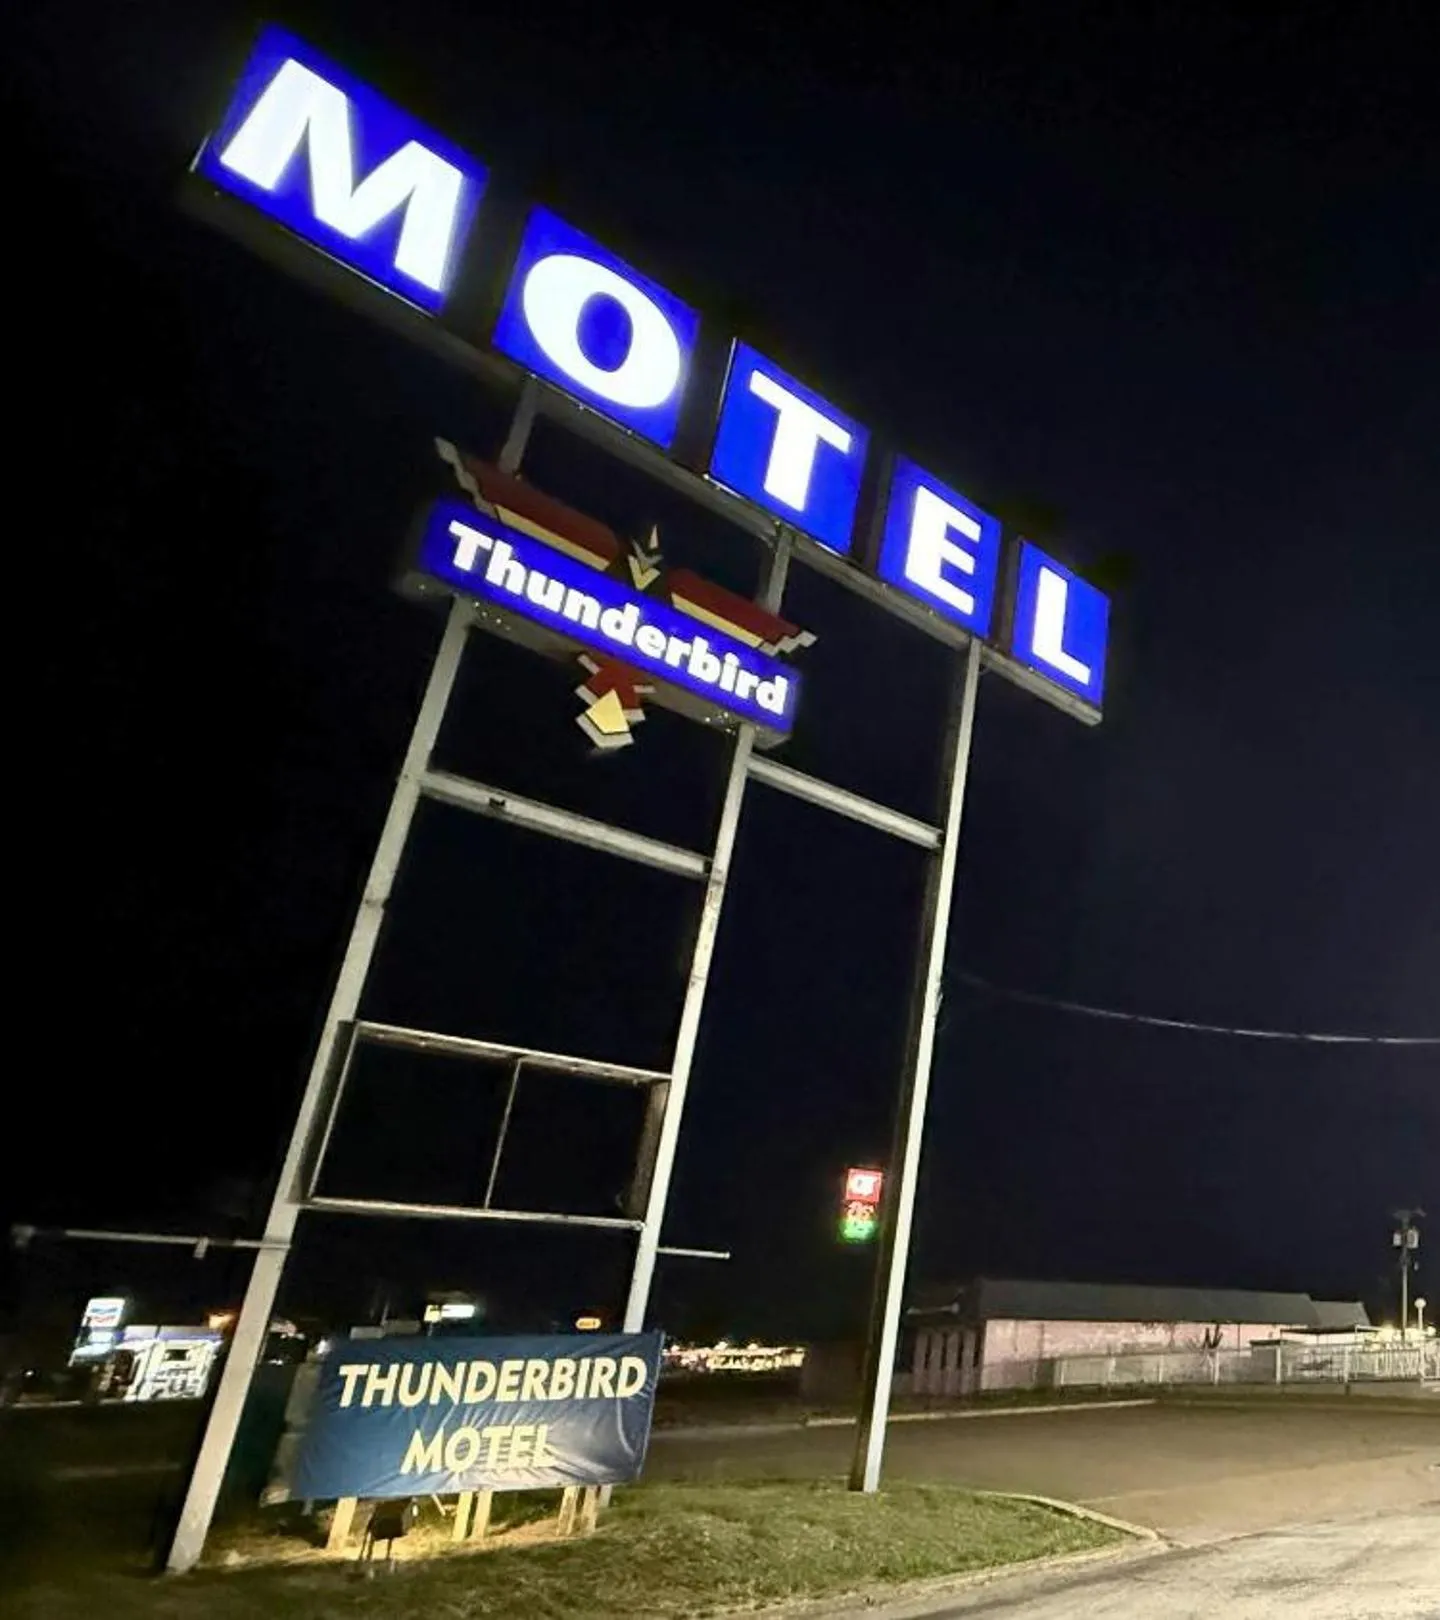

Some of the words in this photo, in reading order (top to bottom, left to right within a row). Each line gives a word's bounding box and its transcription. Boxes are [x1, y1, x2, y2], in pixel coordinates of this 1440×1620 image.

[219, 57, 1091, 685] MOTEL
[449, 519, 788, 716] Thunderbird
[338, 1356, 648, 1408] THUNDERBIRD
[400, 1424, 557, 1475] MOTEL
